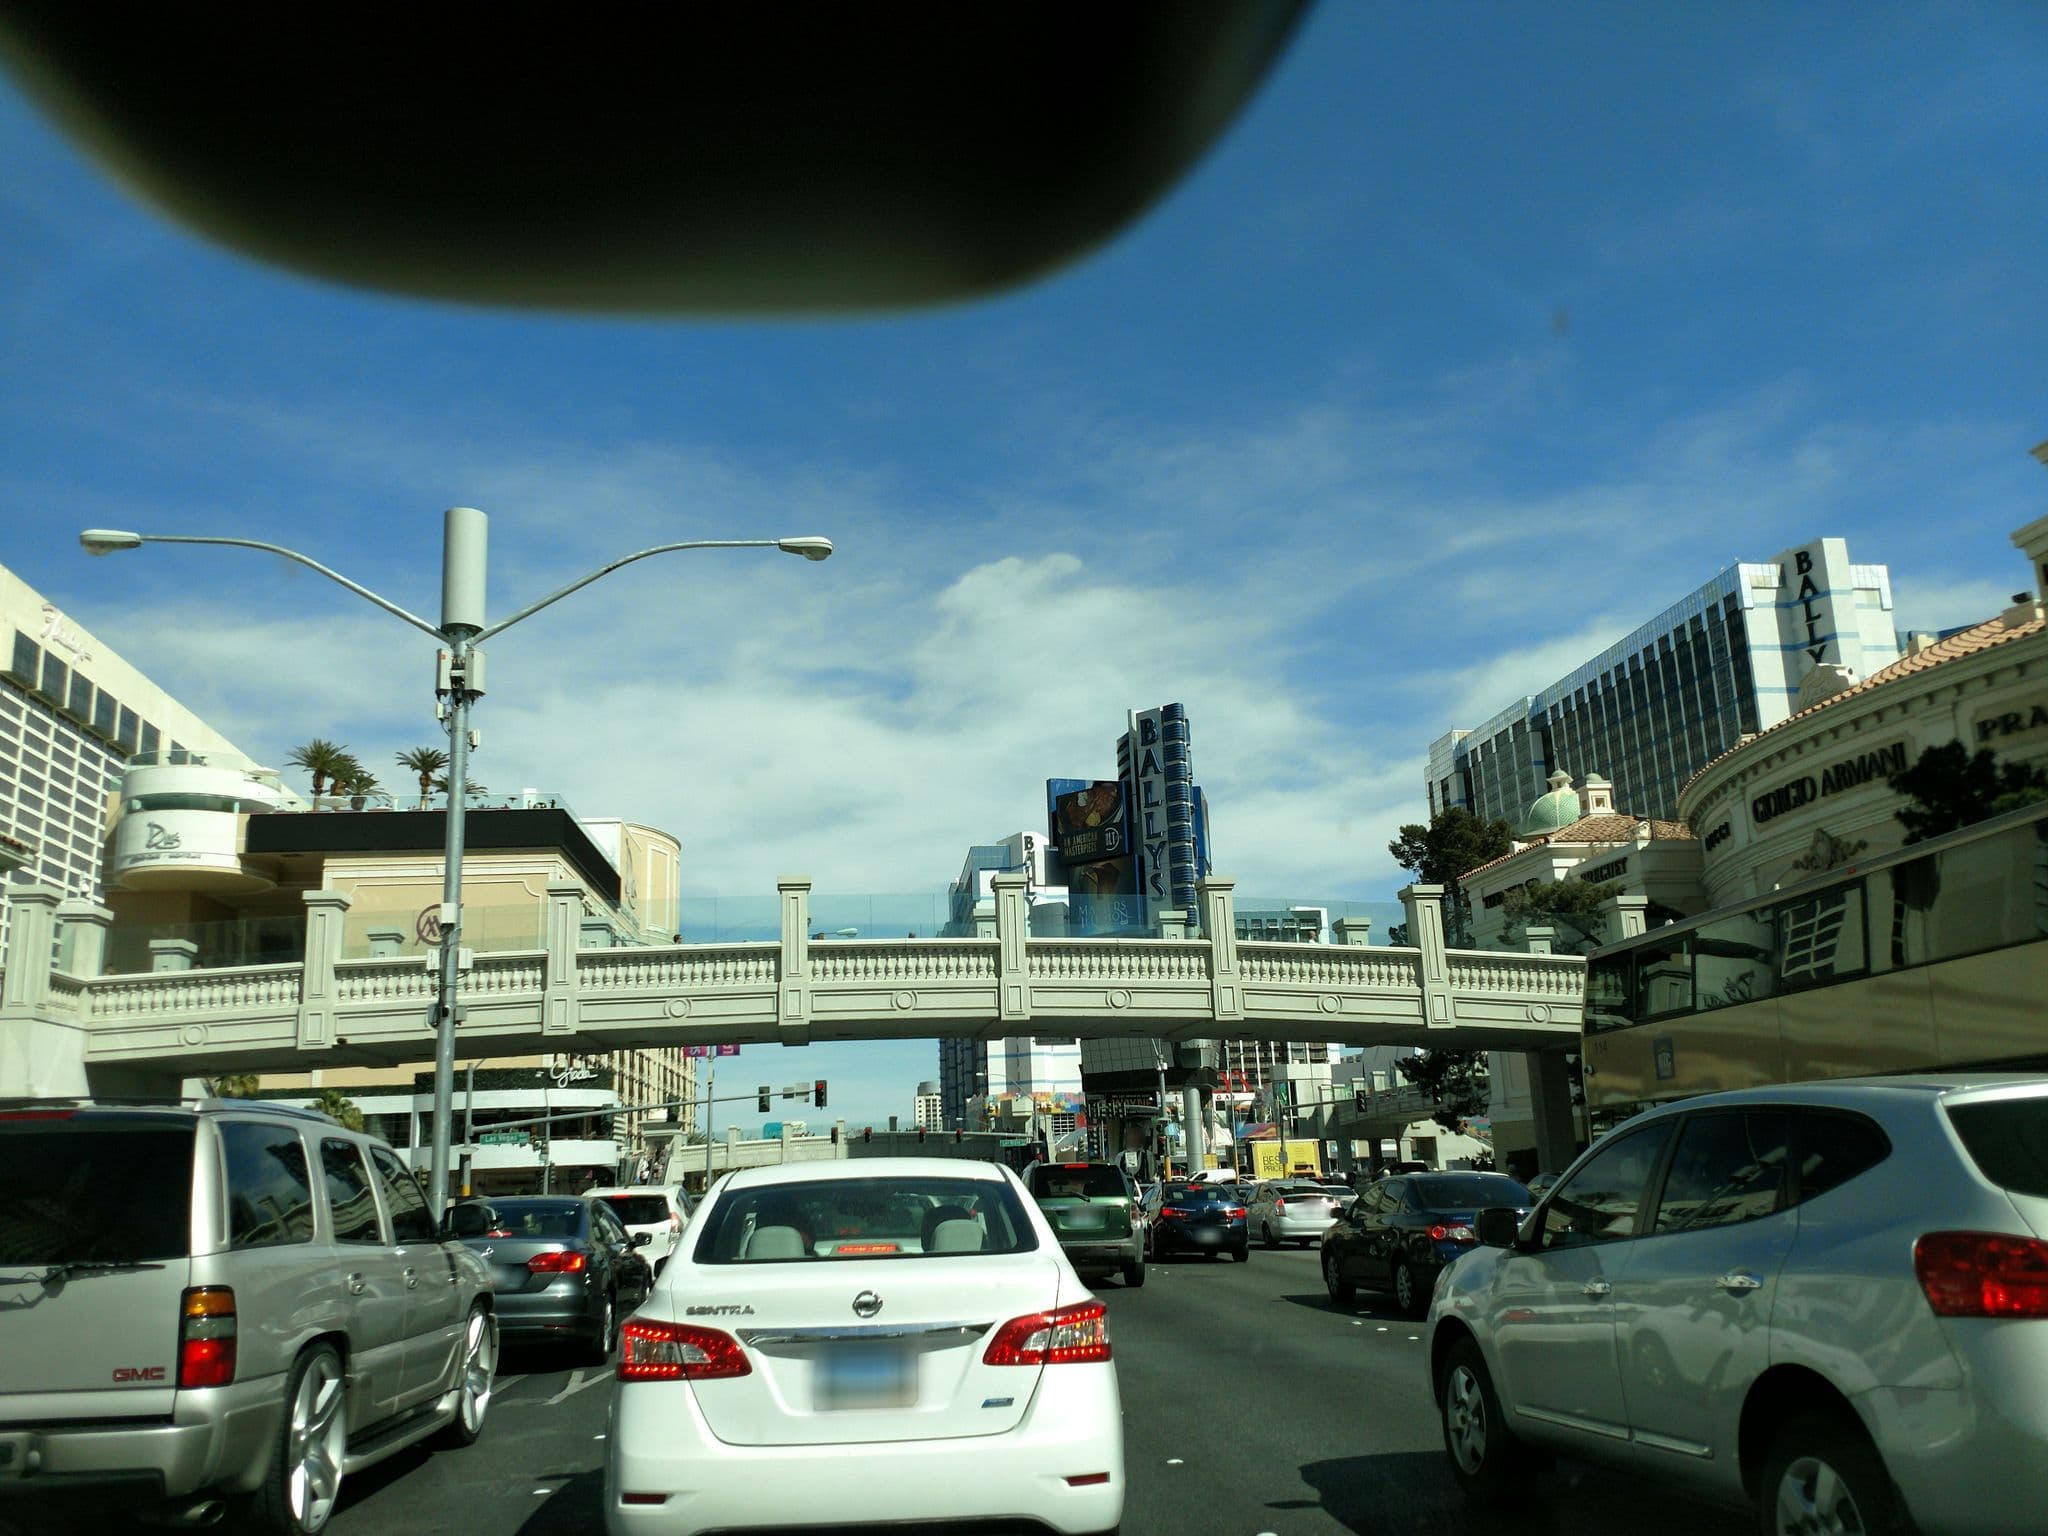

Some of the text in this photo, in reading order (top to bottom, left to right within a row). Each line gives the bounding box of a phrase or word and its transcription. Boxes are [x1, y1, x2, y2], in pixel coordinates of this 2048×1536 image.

[1752, 742, 1907, 823] GIORGIO ARMANI
[686, 1304, 756, 1316] SENTRA
[112, 1366, 167, 1382] GMC
